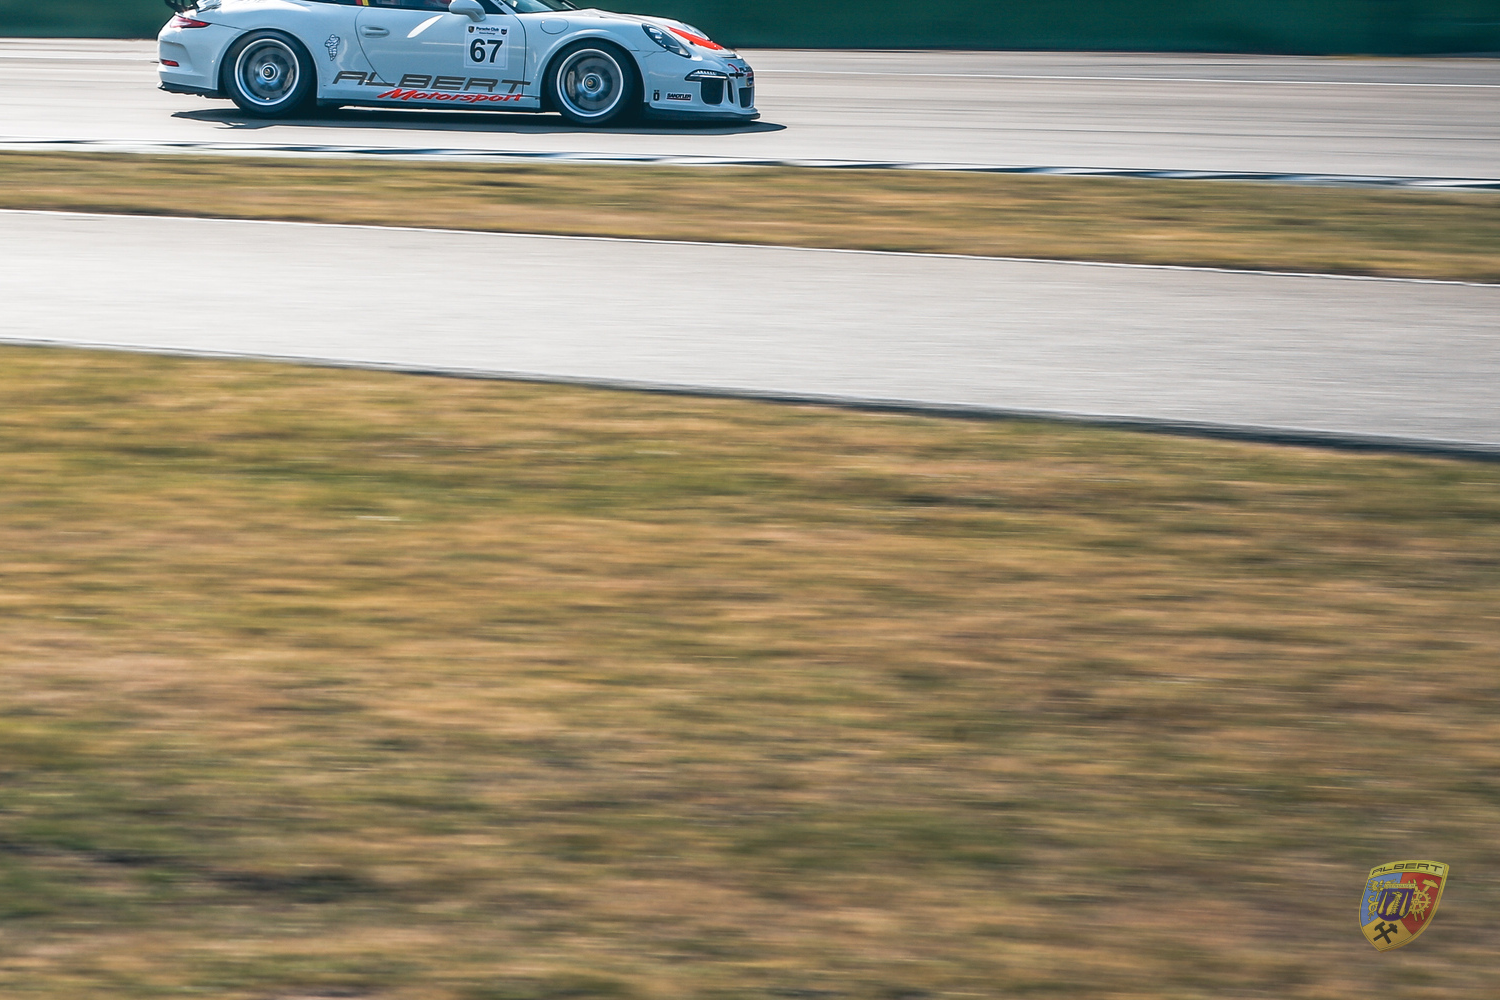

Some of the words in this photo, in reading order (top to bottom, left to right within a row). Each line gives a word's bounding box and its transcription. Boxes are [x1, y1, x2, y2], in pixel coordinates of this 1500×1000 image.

[470, 38, 503, 63] 67
[332, 70, 531, 94] ALBERT
[377, 88, 524, 103] Motorsport
